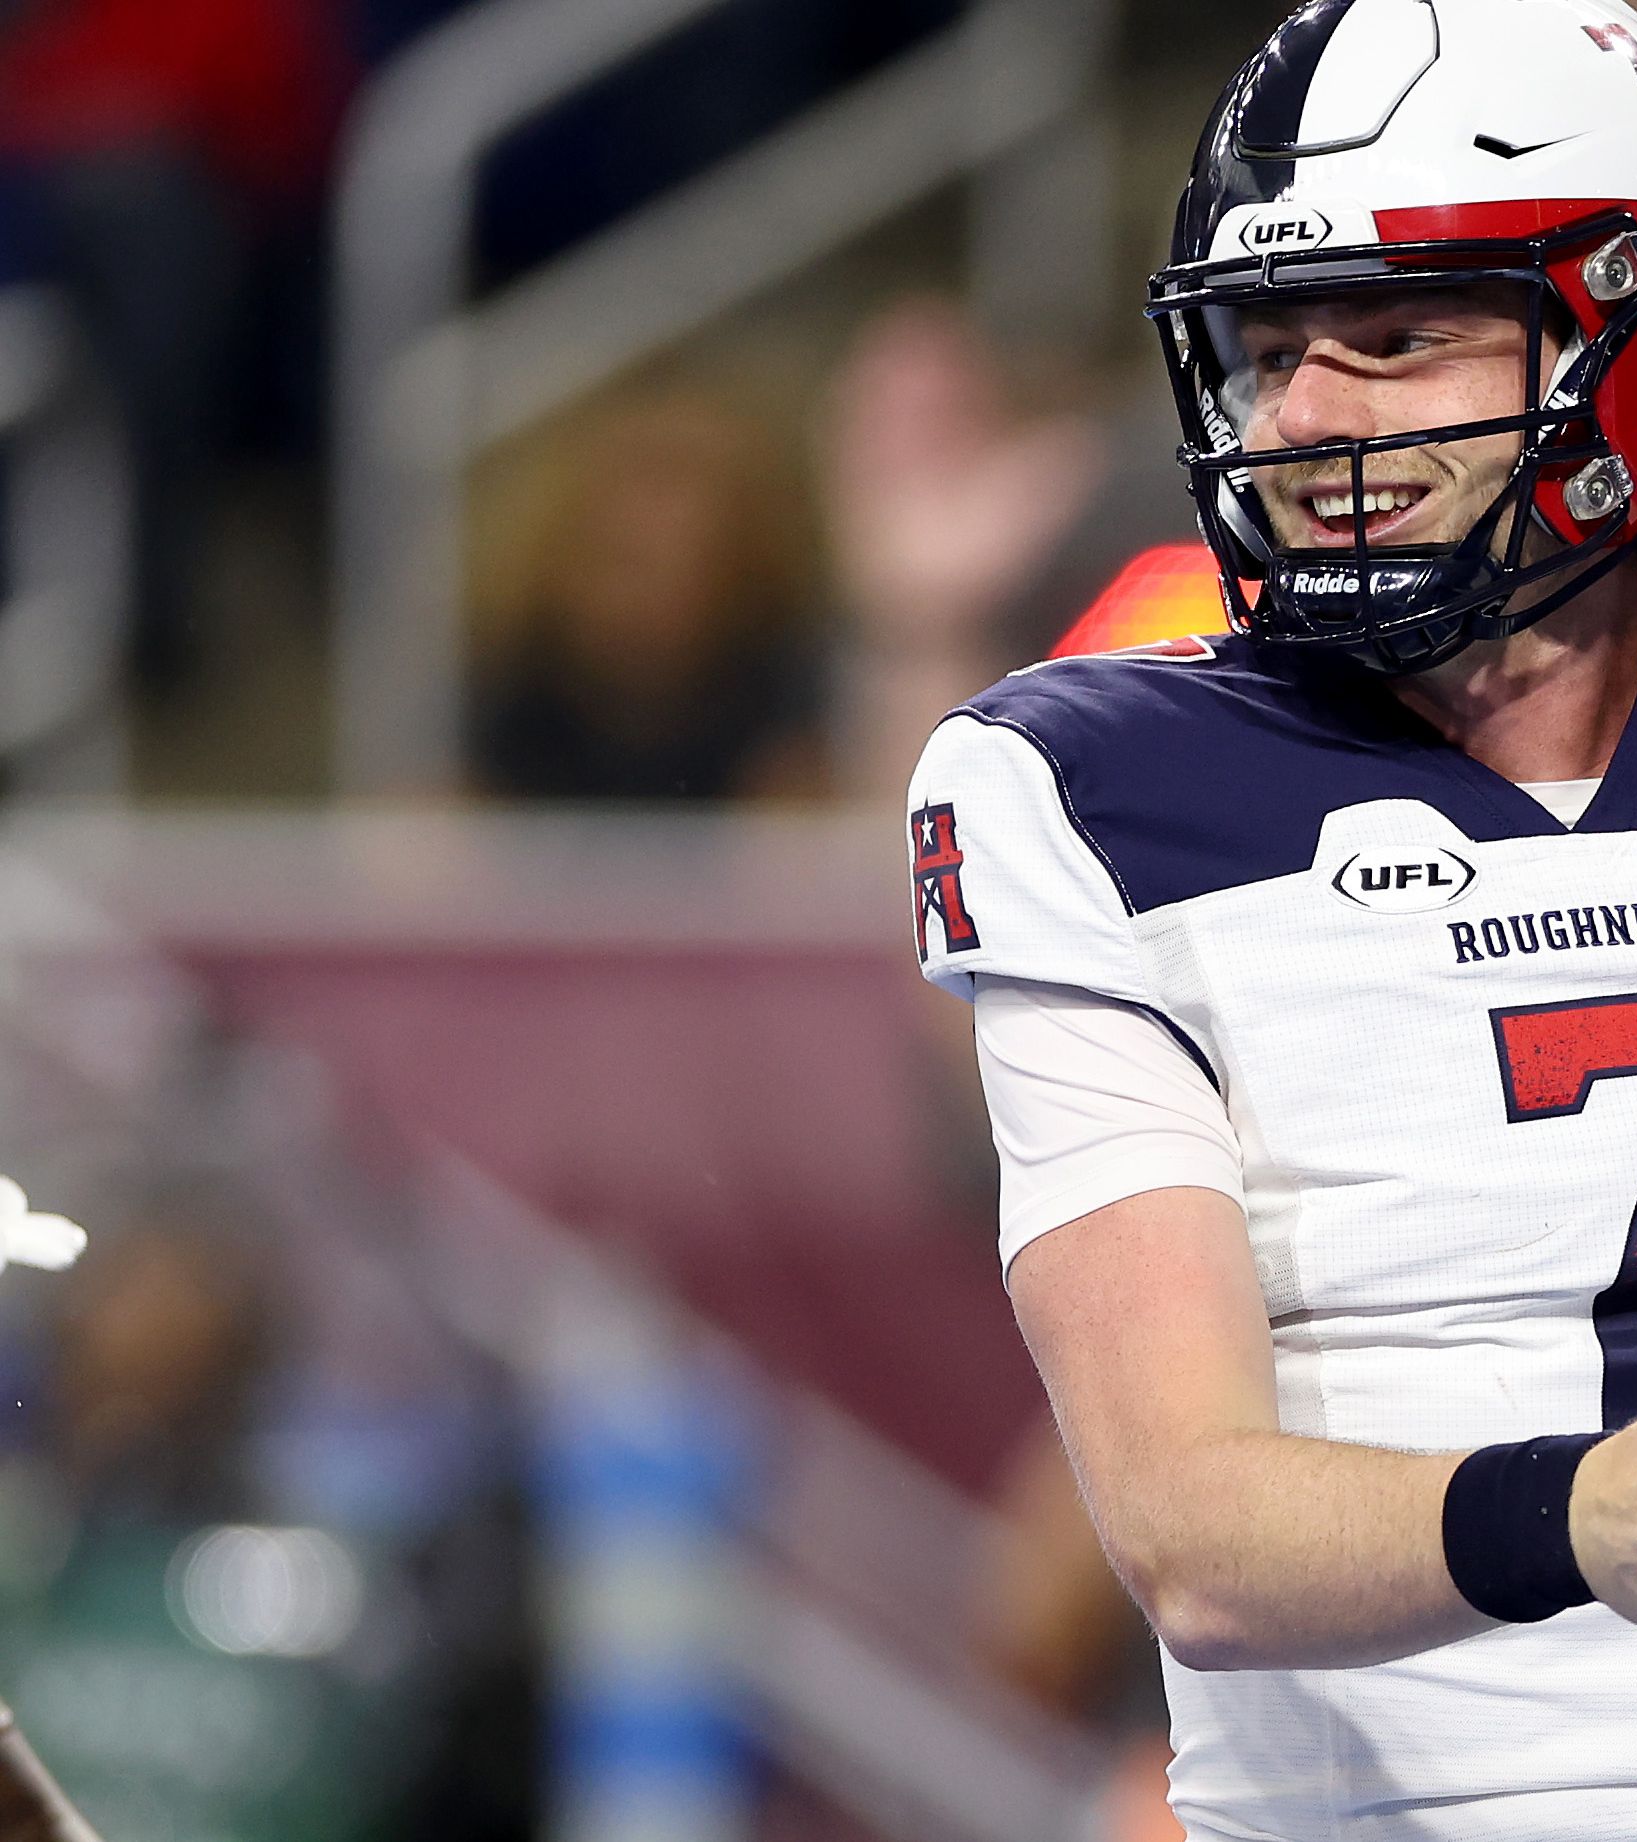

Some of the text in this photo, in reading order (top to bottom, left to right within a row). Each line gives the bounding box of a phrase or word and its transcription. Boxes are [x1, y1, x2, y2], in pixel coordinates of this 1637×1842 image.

[1255, 221, 1314, 244] UFL
[1200, 387, 1252, 486] Riddll
[1360, 863, 1453, 891] UFL
